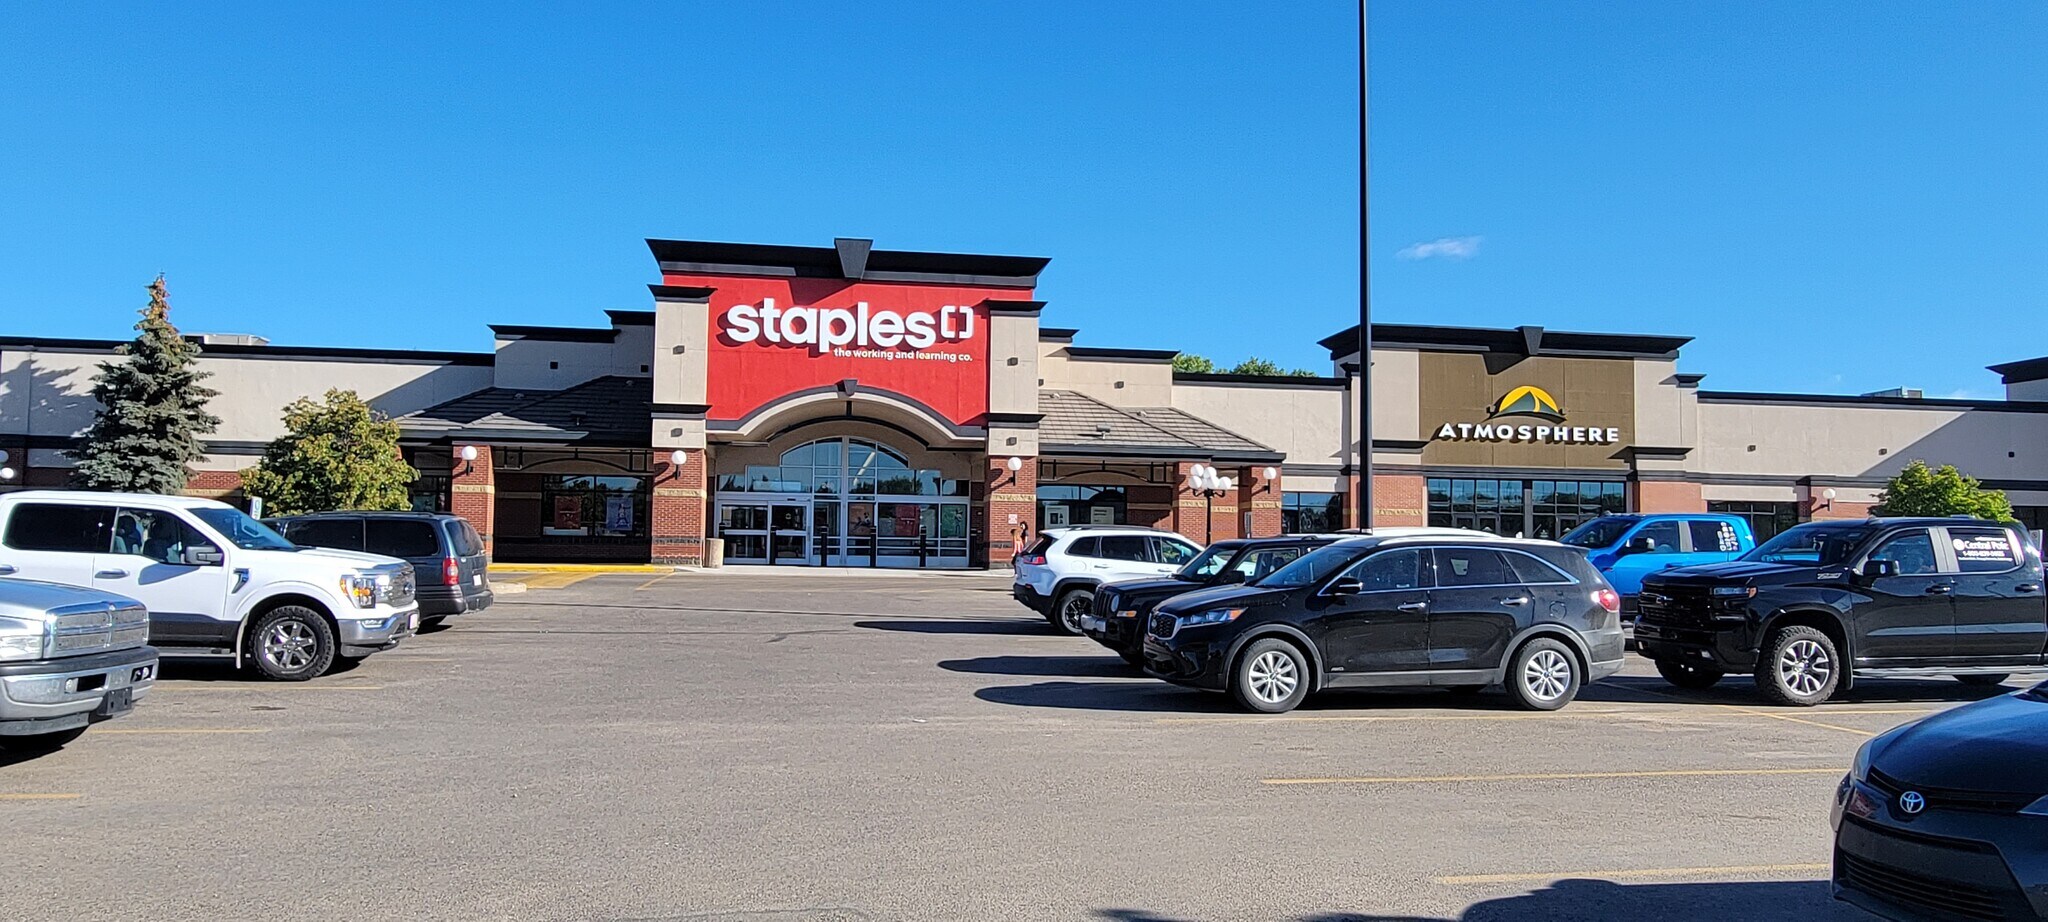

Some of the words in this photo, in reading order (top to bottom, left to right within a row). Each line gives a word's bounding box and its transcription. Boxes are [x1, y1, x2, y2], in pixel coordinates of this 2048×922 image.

[726, 297, 936, 352] staples
[833, 348, 852, 357] the
[852, 349, 893, 360] working
[895, 350, 915, 359] and
[916, 351, 957, 362] learning
[958, 353, 973, 361] co.
[1438, 422, 1620, 442] ATMOSPHERE
